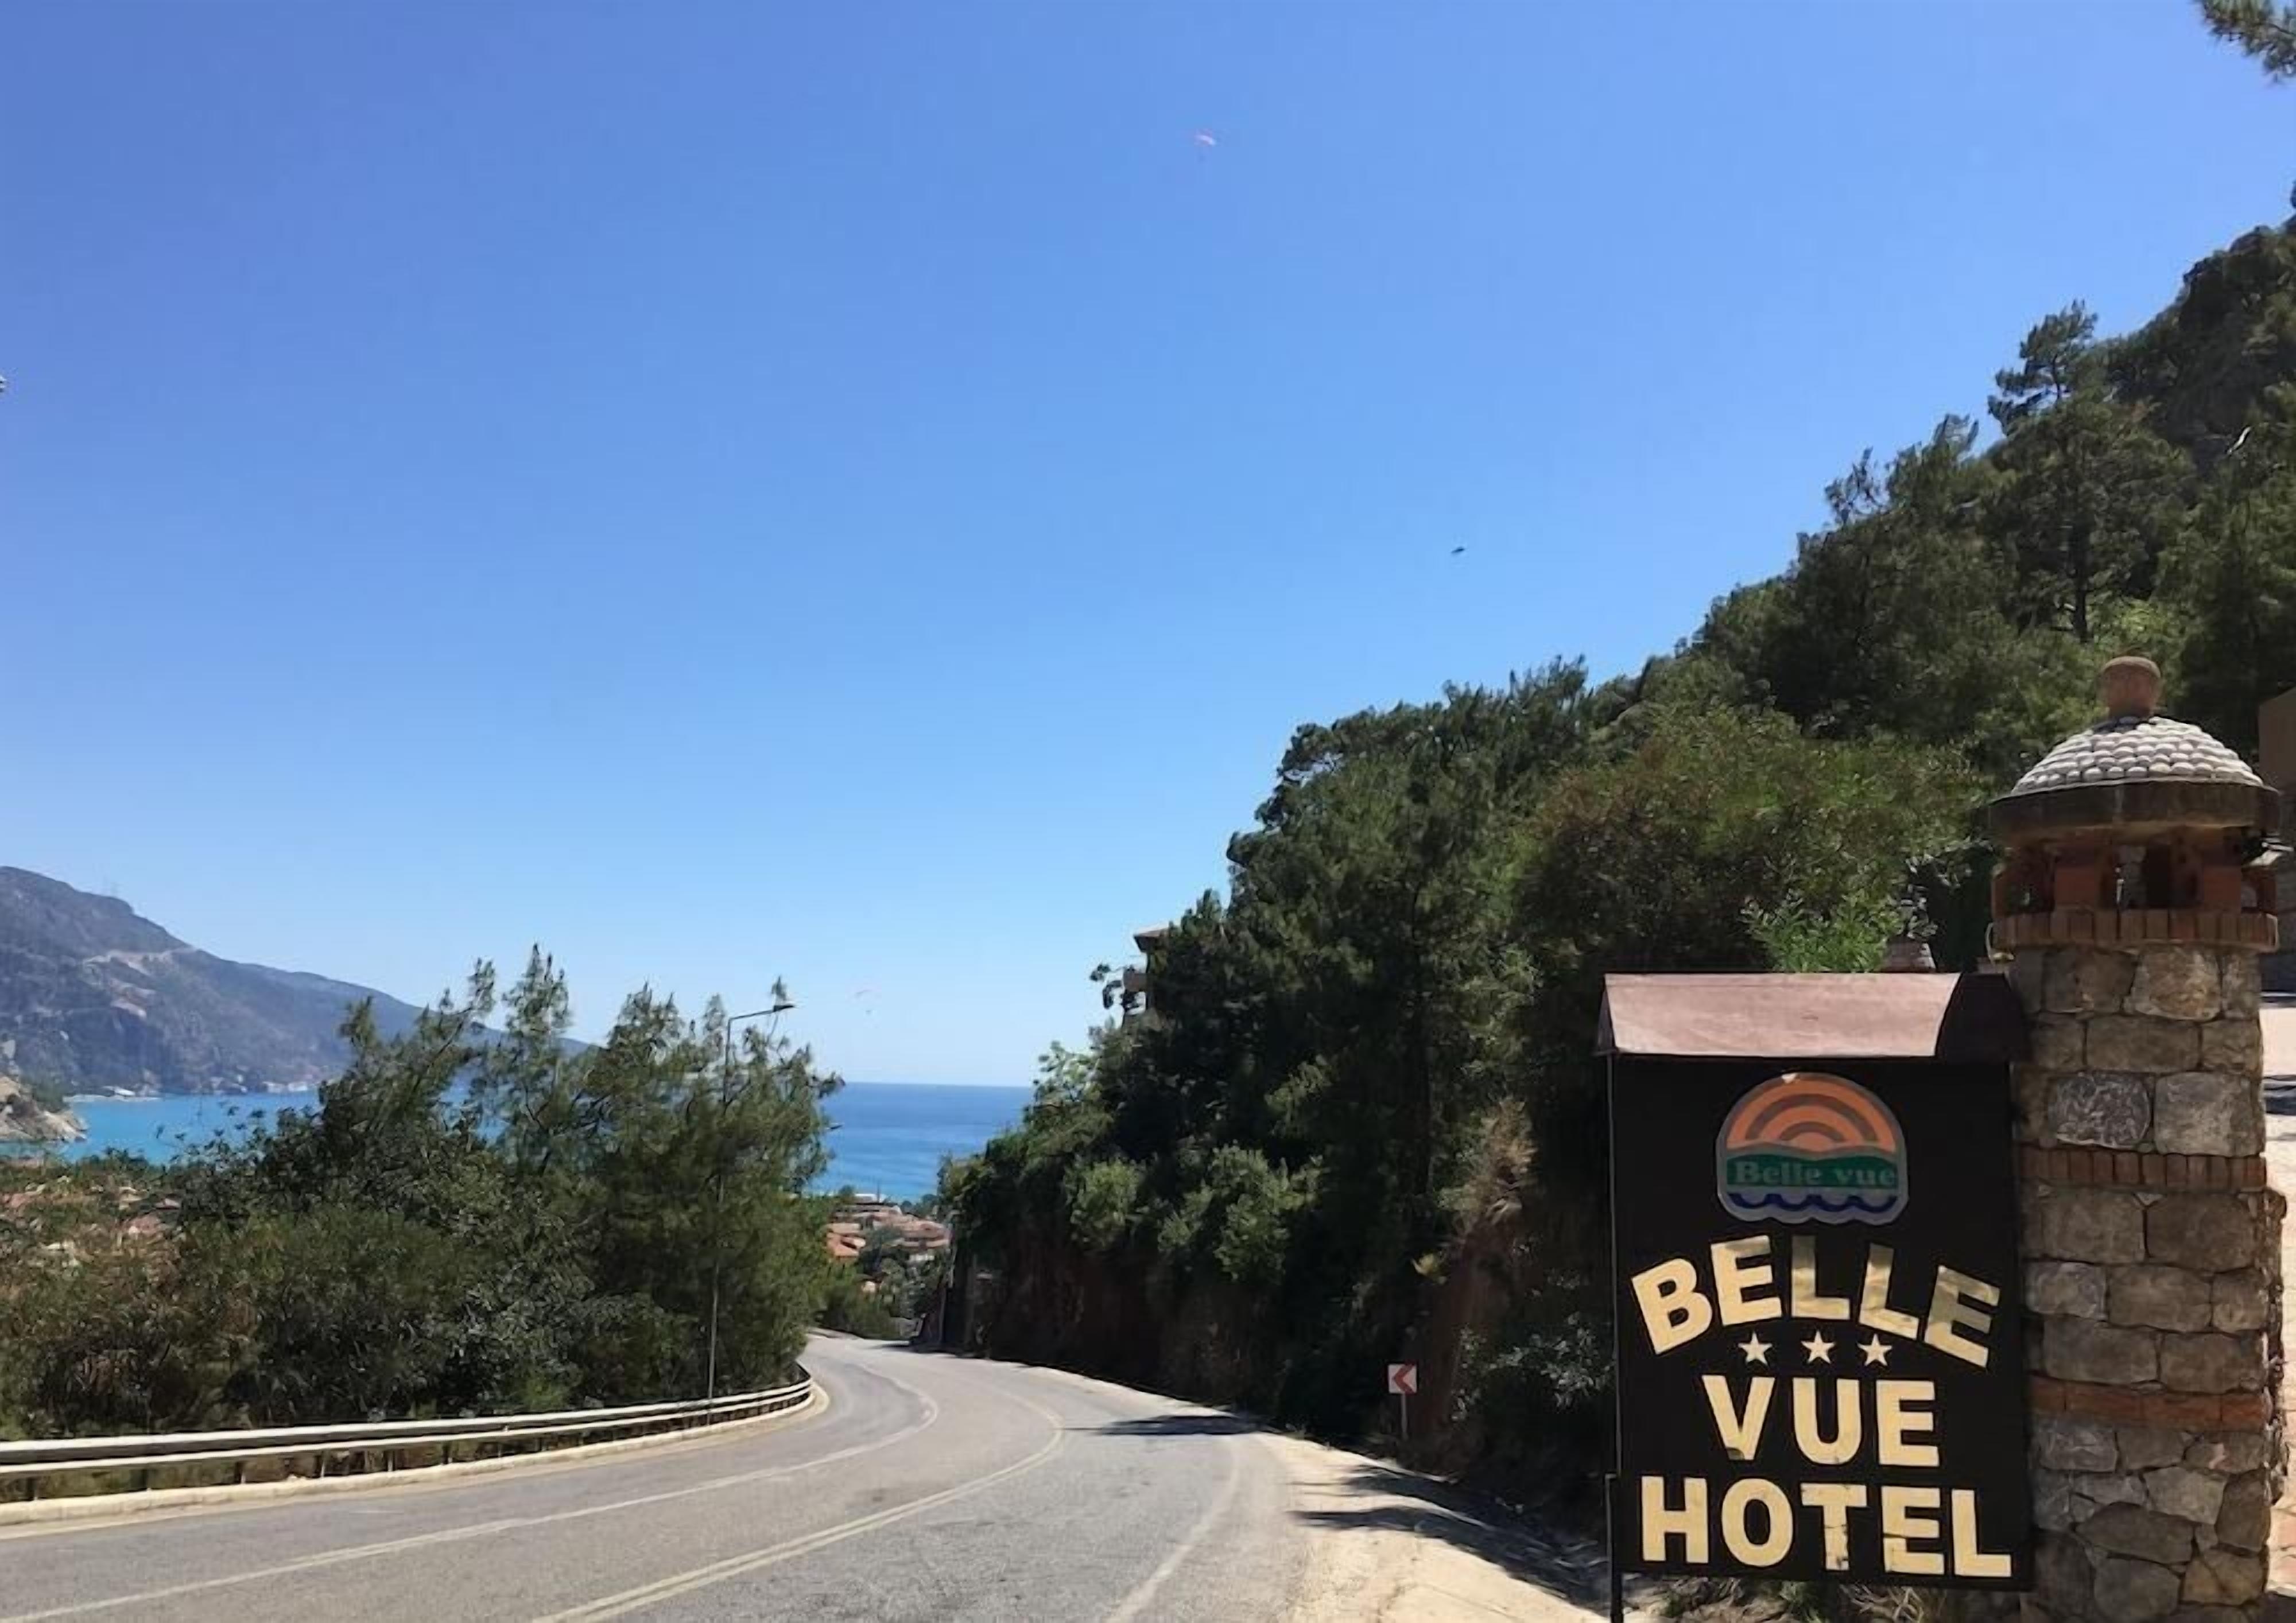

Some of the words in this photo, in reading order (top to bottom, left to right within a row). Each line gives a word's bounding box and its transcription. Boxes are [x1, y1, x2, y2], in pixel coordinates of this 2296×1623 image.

[1735, 1160, 1821, 1186] Belle
[1834, 1167, 1895, 1186] vue
[1631, 1234, 2000, 1368] BELLE
[1702, 1374, 1940, 1467] VUE
[1640, 1475, 2012, 1578] HOTEL
